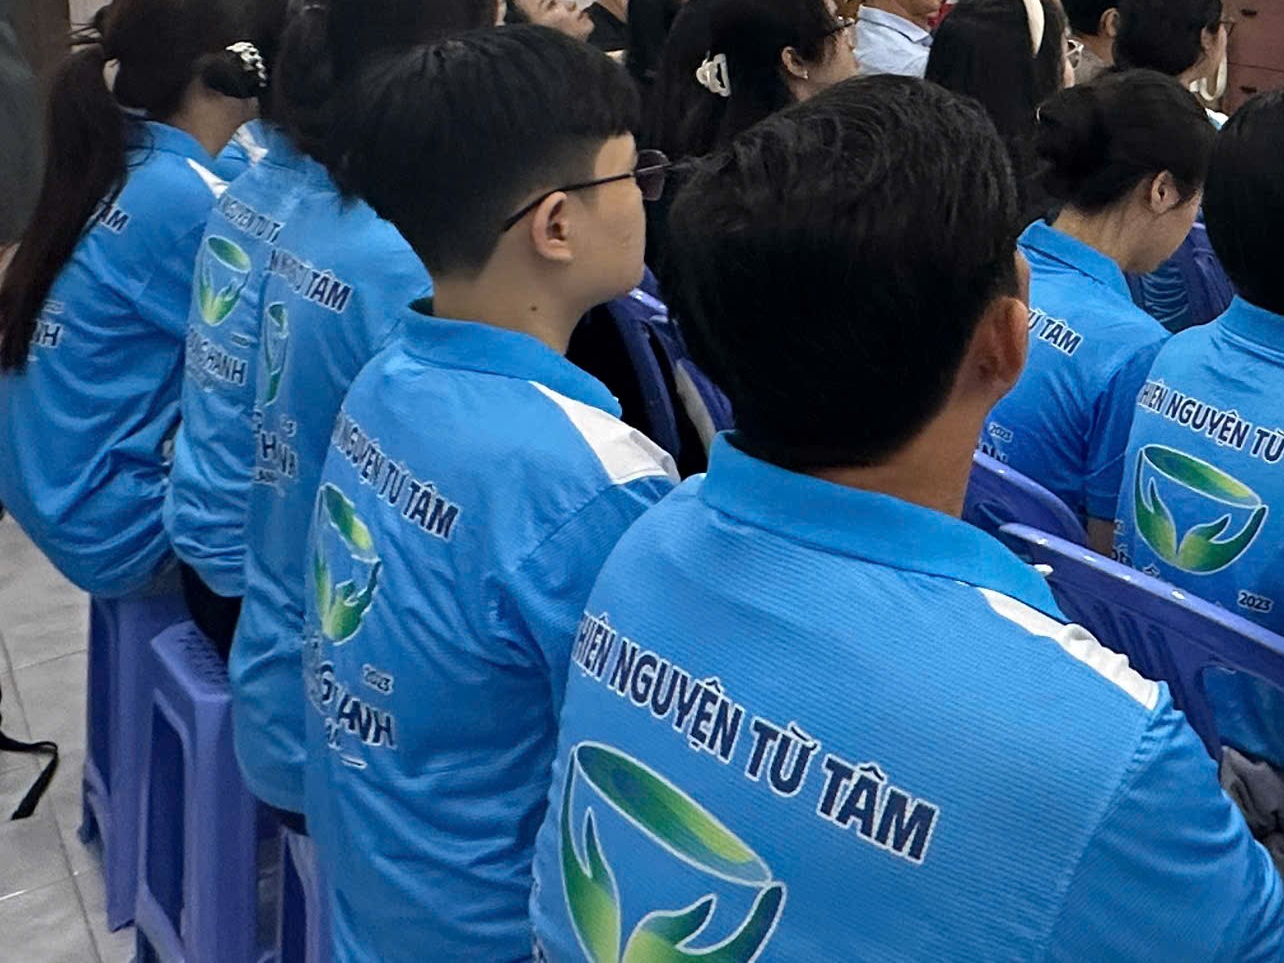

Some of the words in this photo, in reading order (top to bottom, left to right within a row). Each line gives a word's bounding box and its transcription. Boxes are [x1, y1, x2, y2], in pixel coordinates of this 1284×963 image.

[304, 268, 353, 314] TÂM
[1039, 316, 1084, 357] TÂM
[1164, 389, 1253, 451] NGUYỆN
[401, 479, 461, 543] TÂM
[1236, 590, 1275, 614] 2023
[607, 637, 746, 766] NGUYỆN
[744, 715, 821, 798] TỪ
[816, 753, 941, 866] TÂM
